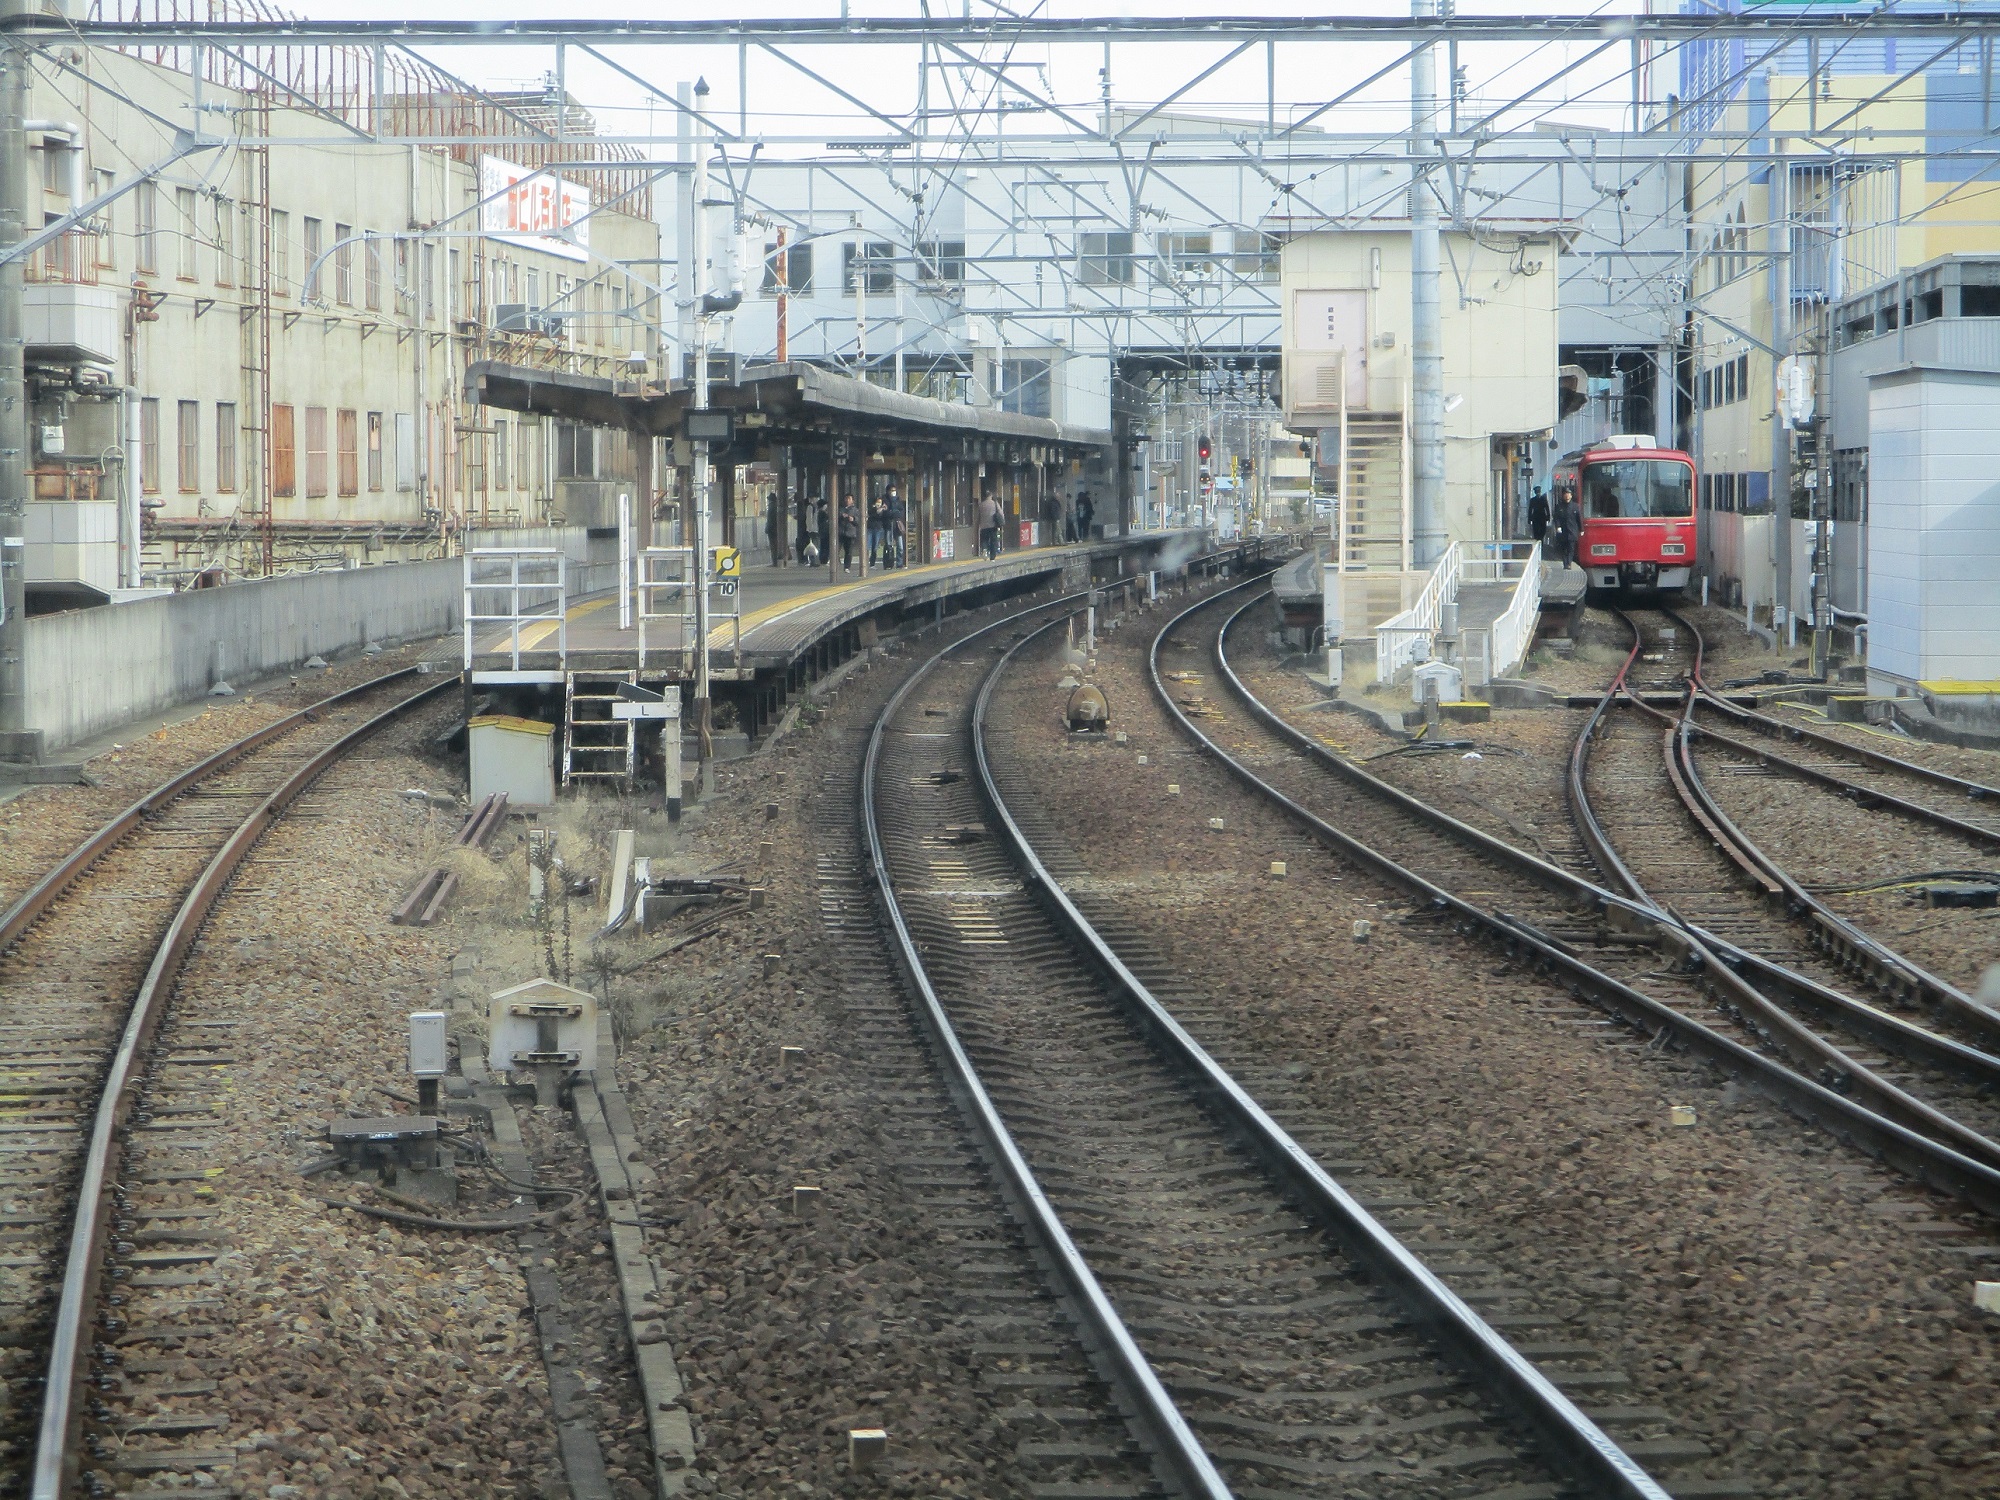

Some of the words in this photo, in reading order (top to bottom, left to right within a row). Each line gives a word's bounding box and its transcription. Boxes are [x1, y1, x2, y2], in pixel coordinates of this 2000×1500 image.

[834, 440, 847, 456] 3
[721, 582, 735, 595] 10
[641, 705, 650, 716] L
